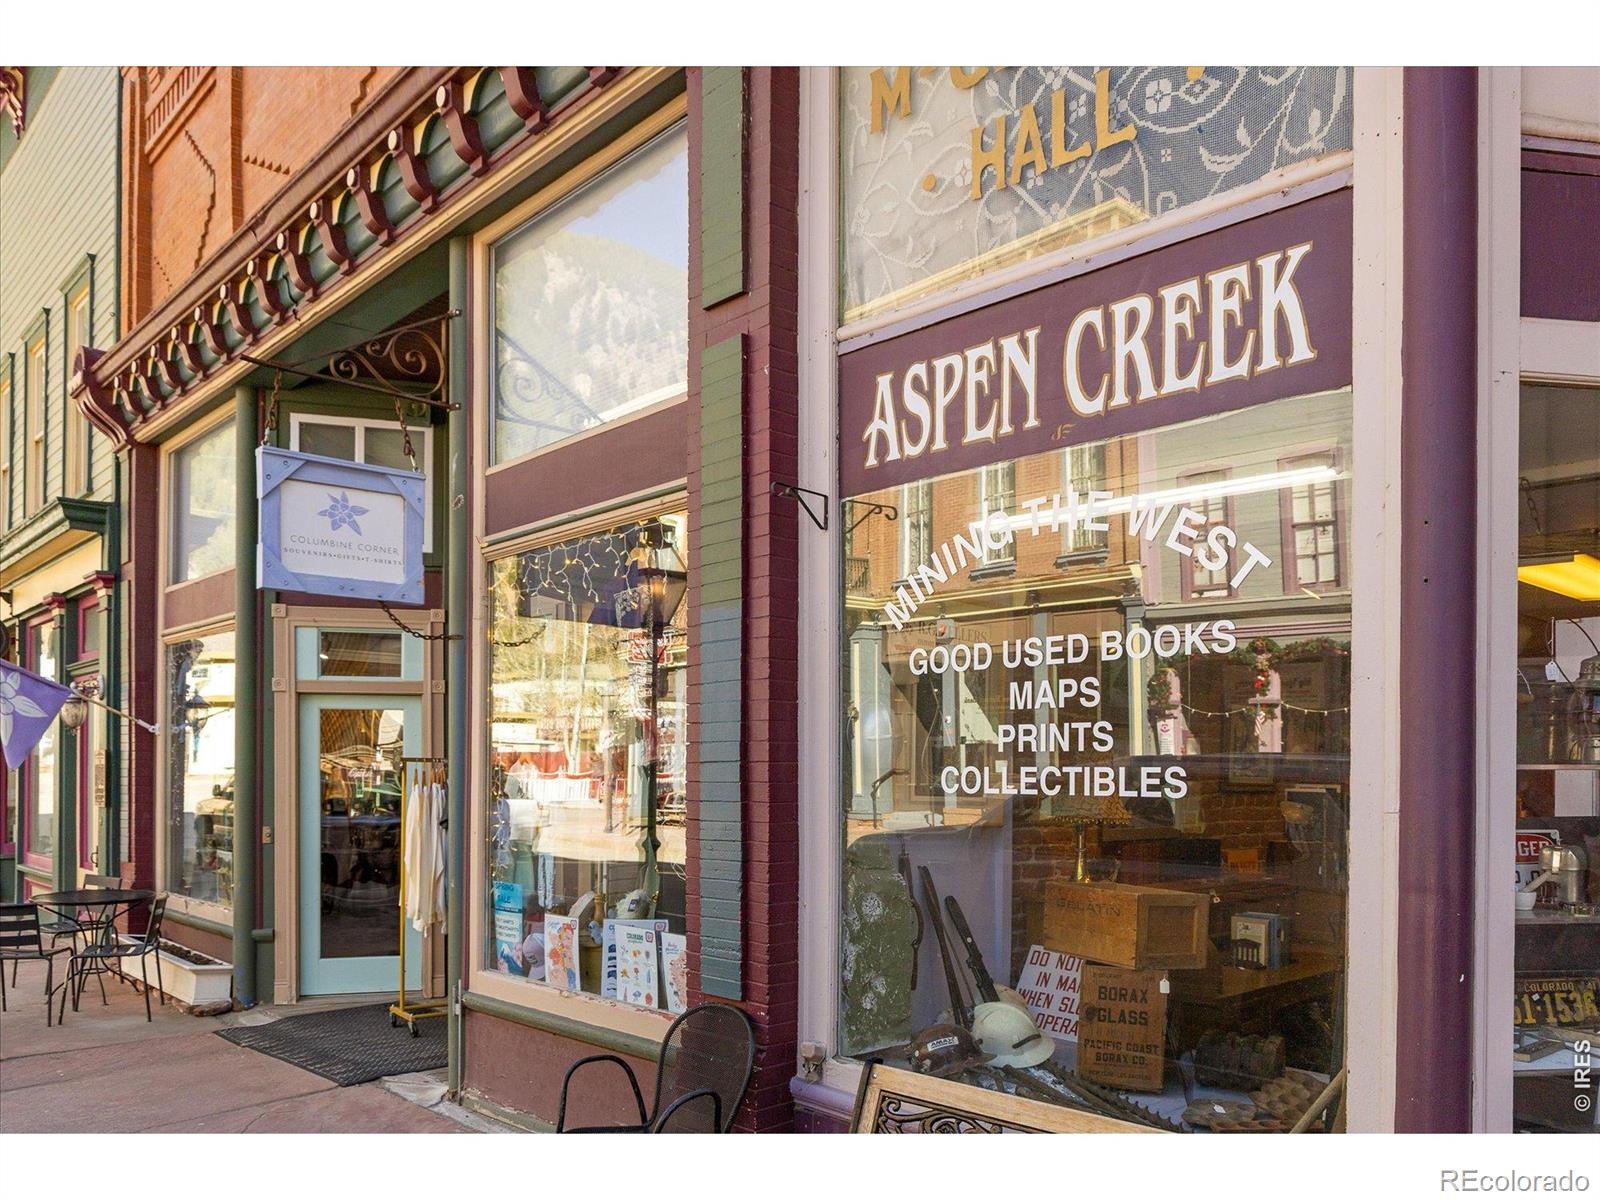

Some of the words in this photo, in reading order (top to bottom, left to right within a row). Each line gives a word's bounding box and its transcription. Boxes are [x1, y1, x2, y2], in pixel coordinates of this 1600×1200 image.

[970, 69, 1137, 200] HALL
[863, 326, 1042, 469] ASPEN
[1063, 240, 1318, 417] CREEK
[290, 534, 353, 550] COLUMBINE
[357, 543, 400, 556] CORNER
[883, 510, 1014, 631] MINING
[1021, 490, 1113, 537] THE
[1128, 493, 1273, 589] WEST
[909, 643, 993, 675] GOOD
[1002, 633, 1089, 669] USED
[1101, 620, 1237, 662] BOOKS
[1009, 676, 1101, 710] MAPS
[998, 720, 1114, 752] PRINTS
[940, 765, 1188, 799] COLLECTIBLES
[1029, 950, 1051, 967] DO
[1055, 954, 1082, 973] NOT
[1035, 971, 1052, 988] IN
[1524, 982, 1575, 992] COLORADO
[1019, 988, 1054, 1009] WHEN
[1098, 985, 1149, 1004] BORAX
[1036, 1012, 1079, 1036] OPERA
[1097, 1007, 1149, 1026] GLASS
[1083, 1038, 1122, 1051] PACIFIC
[1126, 1042, 1159, 1055] COAST
[1095, 1051, 1129, 1064] BORAX
